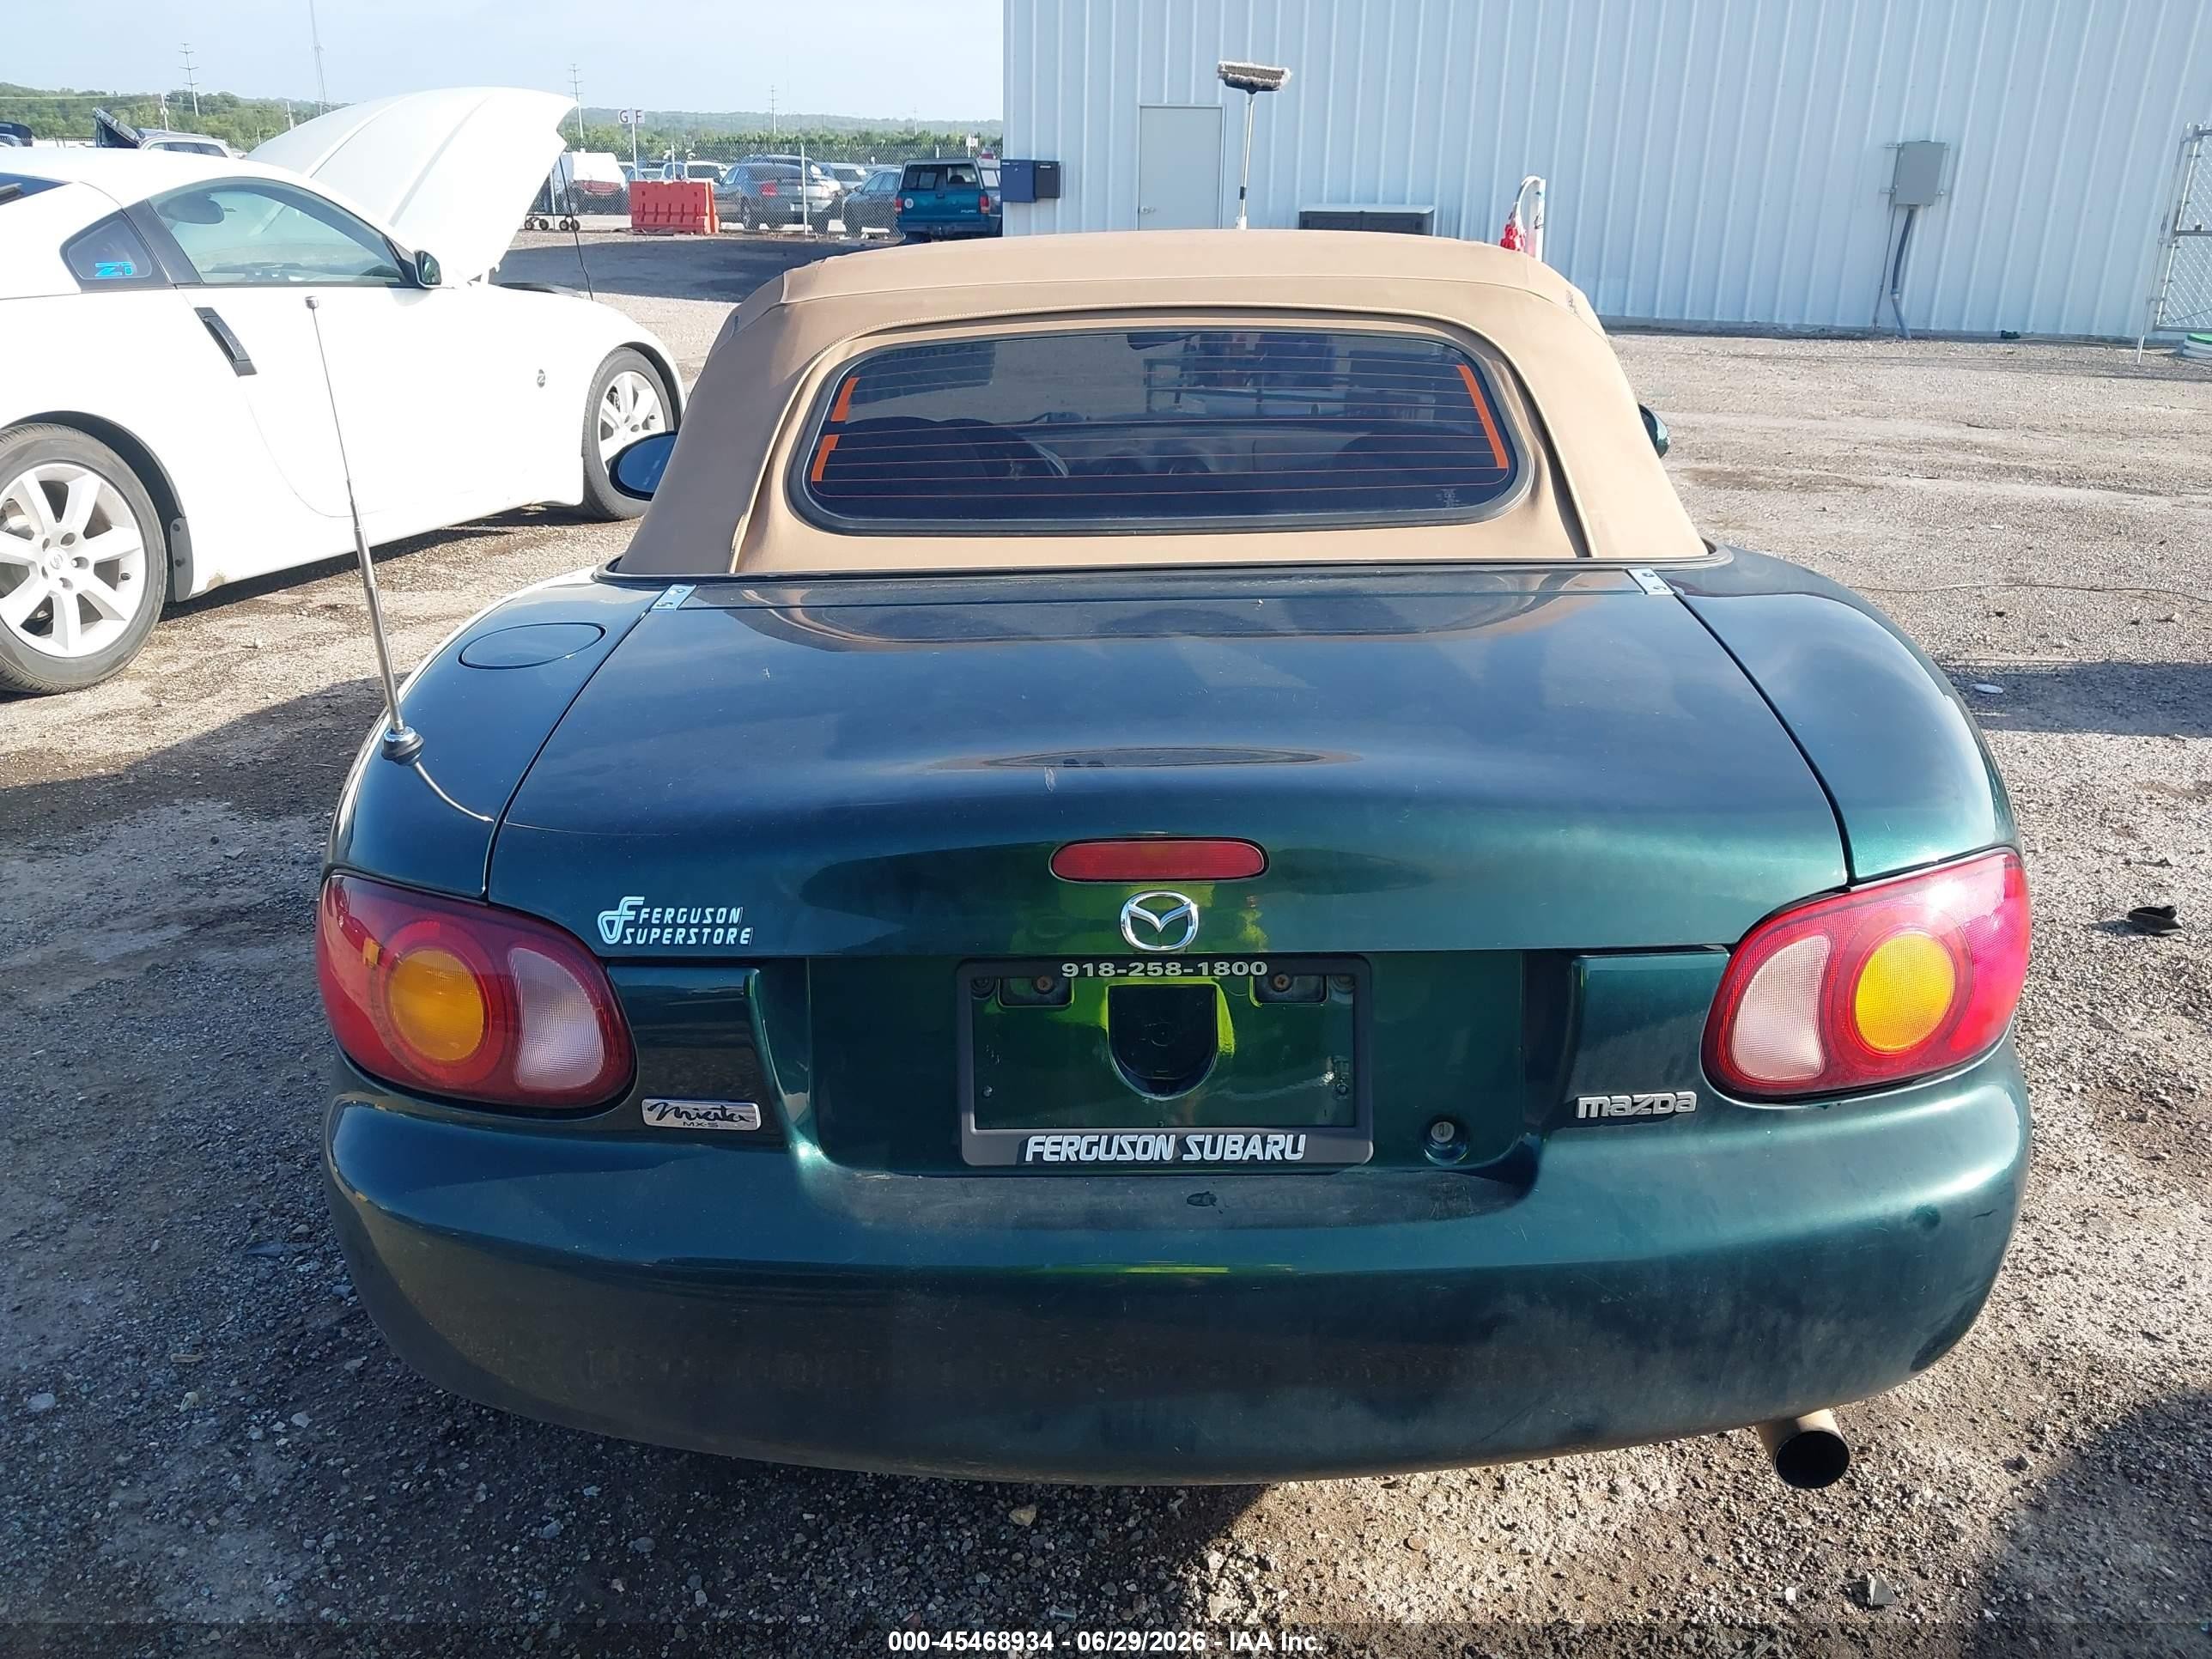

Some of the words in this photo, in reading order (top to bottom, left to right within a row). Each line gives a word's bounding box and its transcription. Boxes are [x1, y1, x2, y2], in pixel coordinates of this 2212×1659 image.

[619, 110, 629, 124] G
[635, 110, 642, 124] F
[638, 906, 744, 925] FERGUSON
[623, 927, 754, 946] SUPERSTORE
[1061, 961, 1268, 977] 918-258-1800
[647, 1102, 755, 1123] Miata
[1025, 1133, 1176, 1162] FERGUSON
[1182, 1133, 1306, 1161] SUBARU
